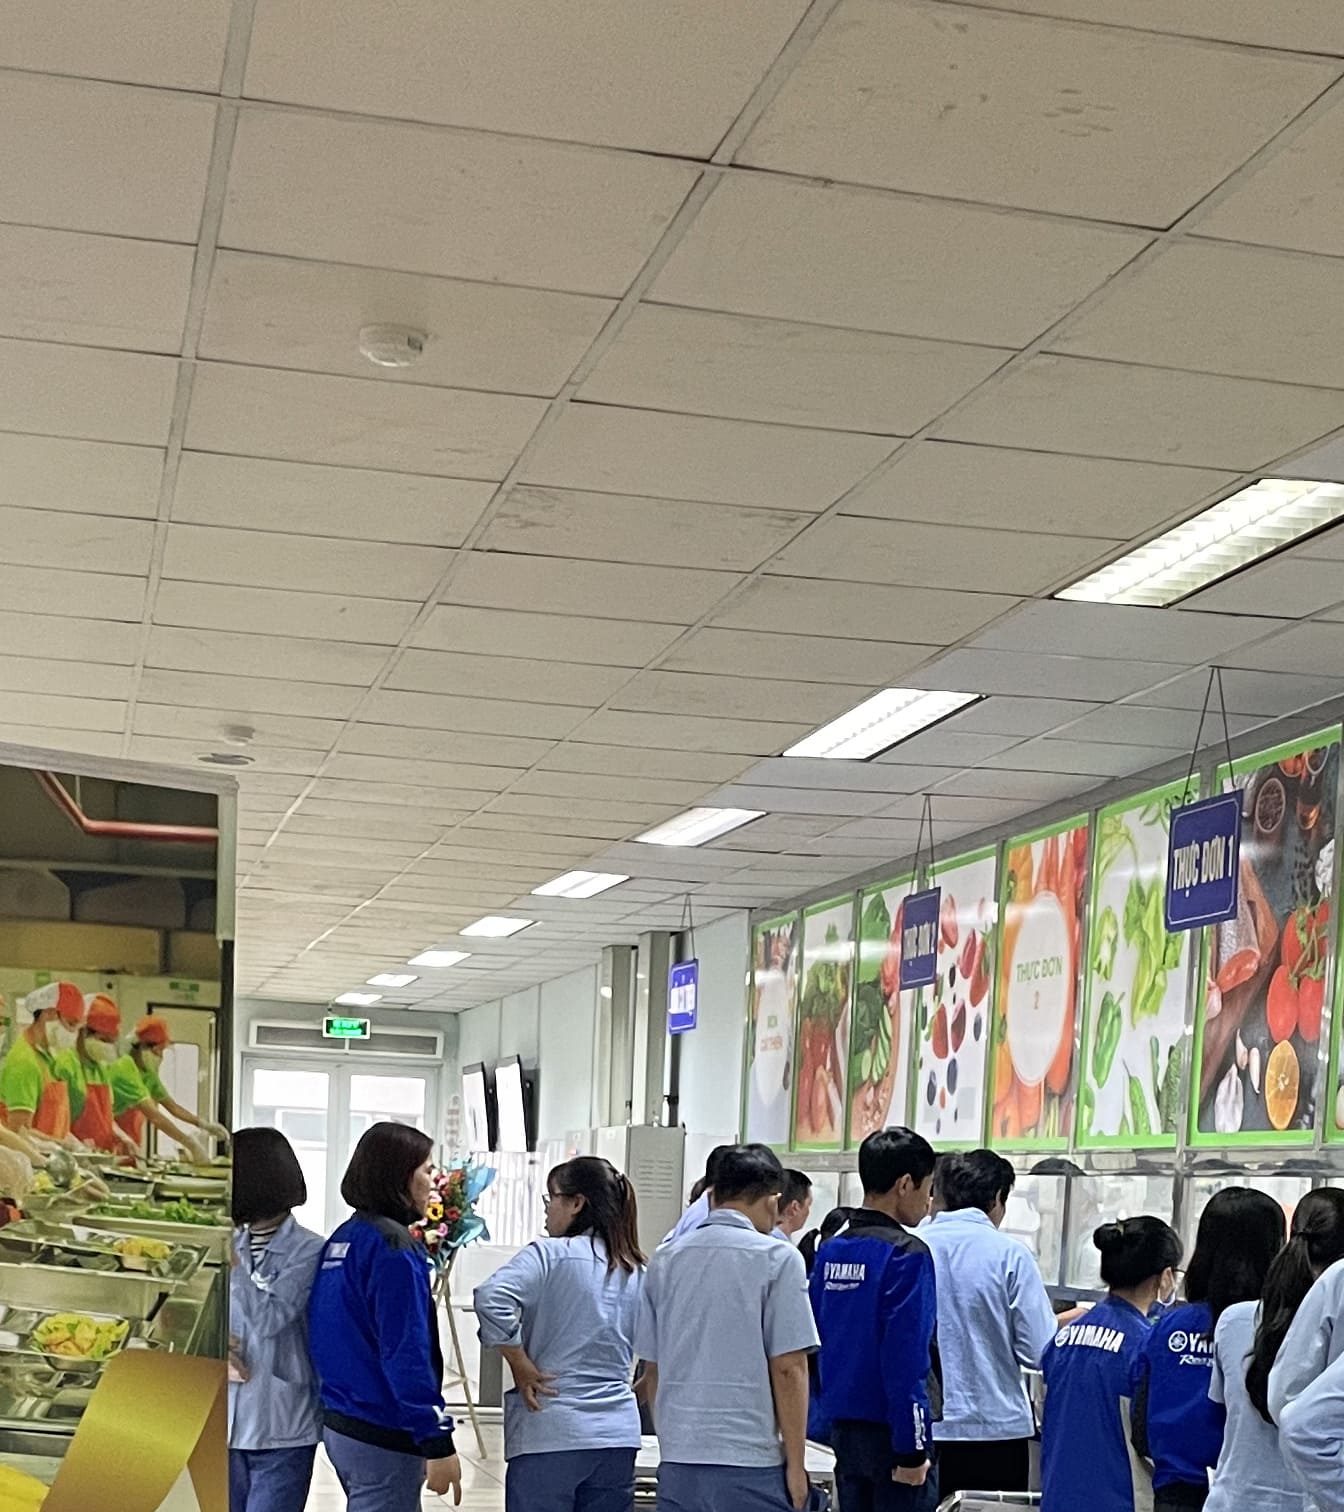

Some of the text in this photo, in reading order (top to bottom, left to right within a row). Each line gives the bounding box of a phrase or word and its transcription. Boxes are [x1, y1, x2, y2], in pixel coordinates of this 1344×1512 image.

[1173, 834, 1234, 899] THỰC ĐƠN 1
[830, 1263, 866, 1281] YAMAHA
[1069, 1324, 1125, 1353] YAMAHA
